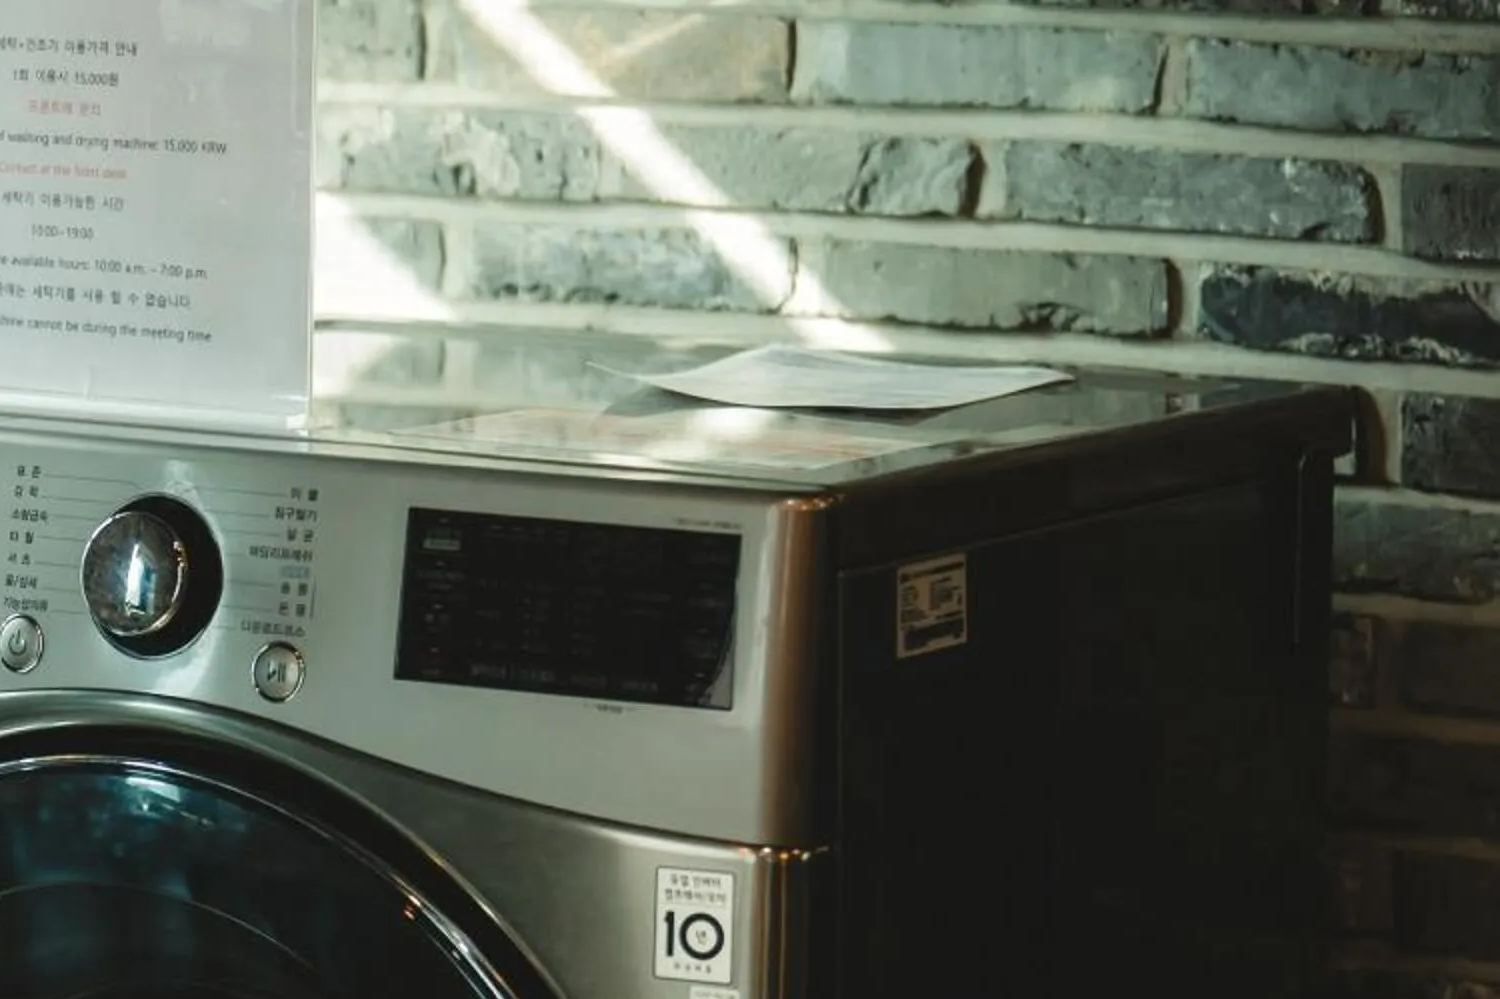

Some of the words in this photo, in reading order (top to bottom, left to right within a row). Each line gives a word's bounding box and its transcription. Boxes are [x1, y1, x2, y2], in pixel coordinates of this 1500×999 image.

[53, 132, 73, 145] and
[27, 318, 62, 332] cannot
[65, 319, 79, 332] be
[82, 321, 118, 338] during
[119, 323, 137, 337] the
[140, 326, 185, 344] meeting
[664, 910, 725, 960] 10
